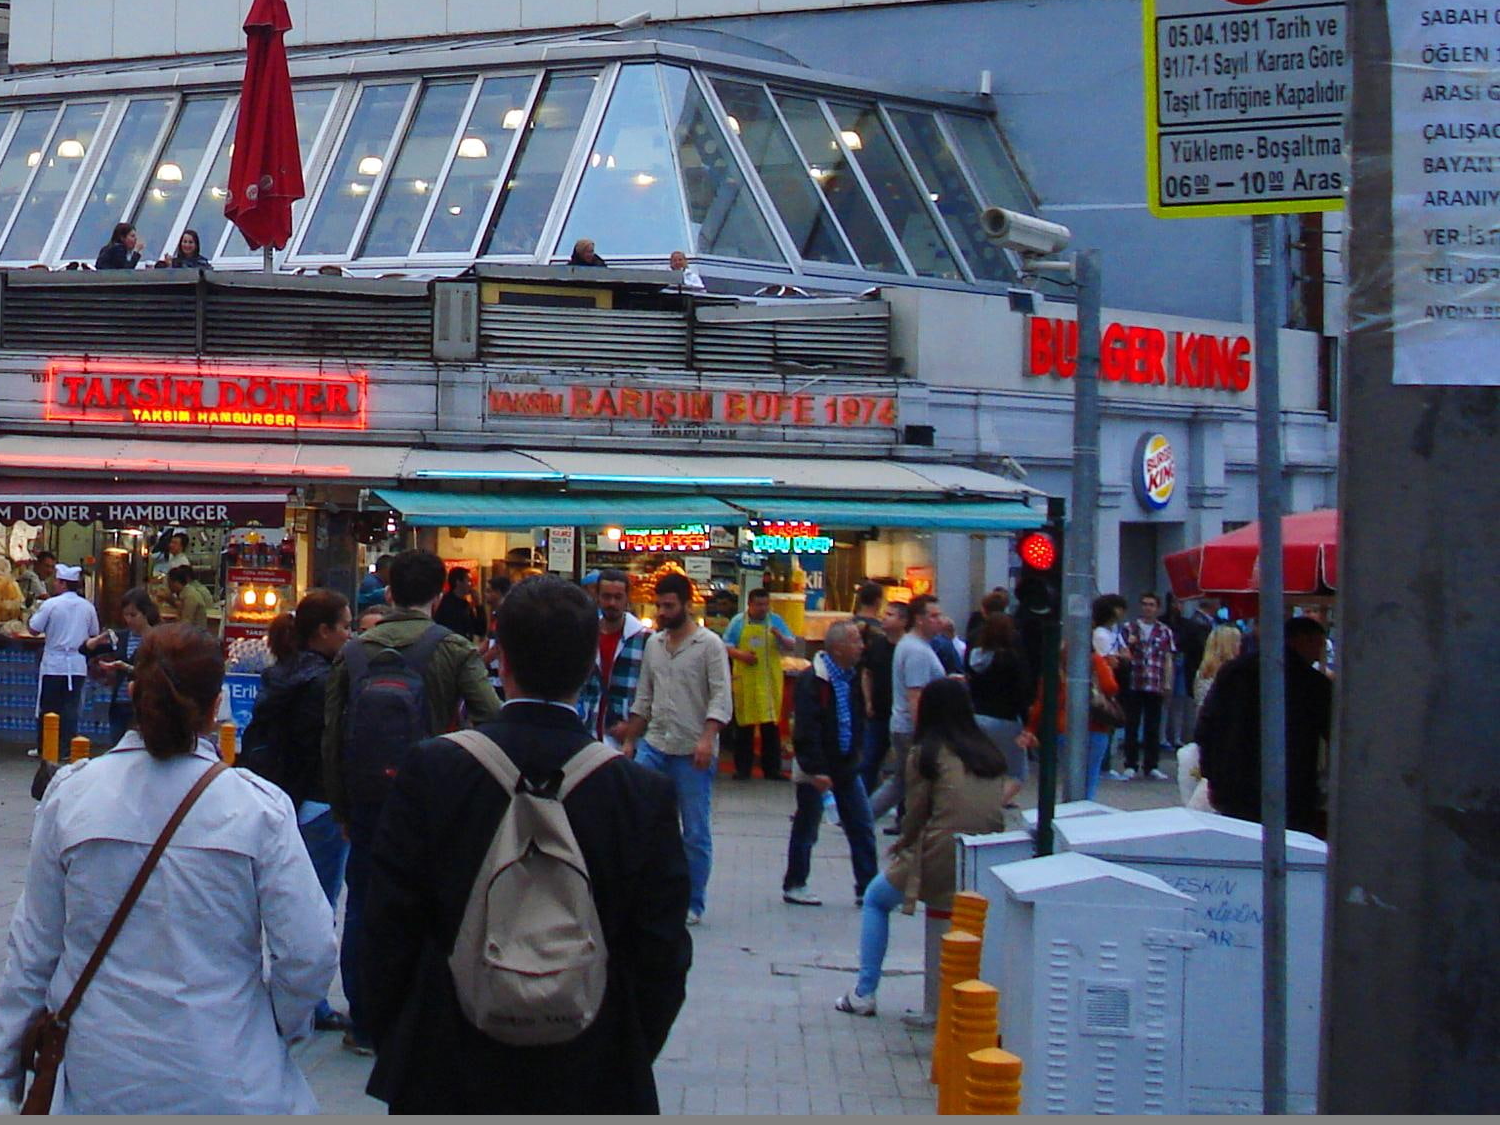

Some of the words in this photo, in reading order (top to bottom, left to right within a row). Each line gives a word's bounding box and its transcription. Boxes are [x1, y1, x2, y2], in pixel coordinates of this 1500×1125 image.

[1167, 19, 1260, 48] 05.04.1991
[1266, 15, 1311, 41] Tarih
[1316, 18, 1337, 37] ve
[1420, 8, 1488, 26] SABAH
[1163, 53, 1208, 79] 91/7-1
[1213, 50, 1252, 80] Sayıl
[1256, 48, 1305, 73] Karara
[1308, 44, 1344, 69] Göre
[1421, 43, 1489, 64] ÖĞLEN
[1163, 89, 1201, 114] Taşıt
[1203, 85, 1271, 115] Trafiğine
[1275, 79, 1346, 110] Kapalıdır
[1170, 138, 1245, 165] Yükleme
[1257, 133, 1342, 164] Boşaltma
[1422, 155, 1493, 174] BAYAN
[1031, 316, 1167, 386] BUGER
[1175, 331, 1251, 393] KING
[62, 373, 204, 408] TAKSİM
[216, 376, 351, 413] DÖNER
[197, 411, 297, 426] HAMBURGER
[825, 394, 898, 426] 1974
[23, 502, 90, 521] DÖNER
[108, 504, 229, 522] HAMBURGER
